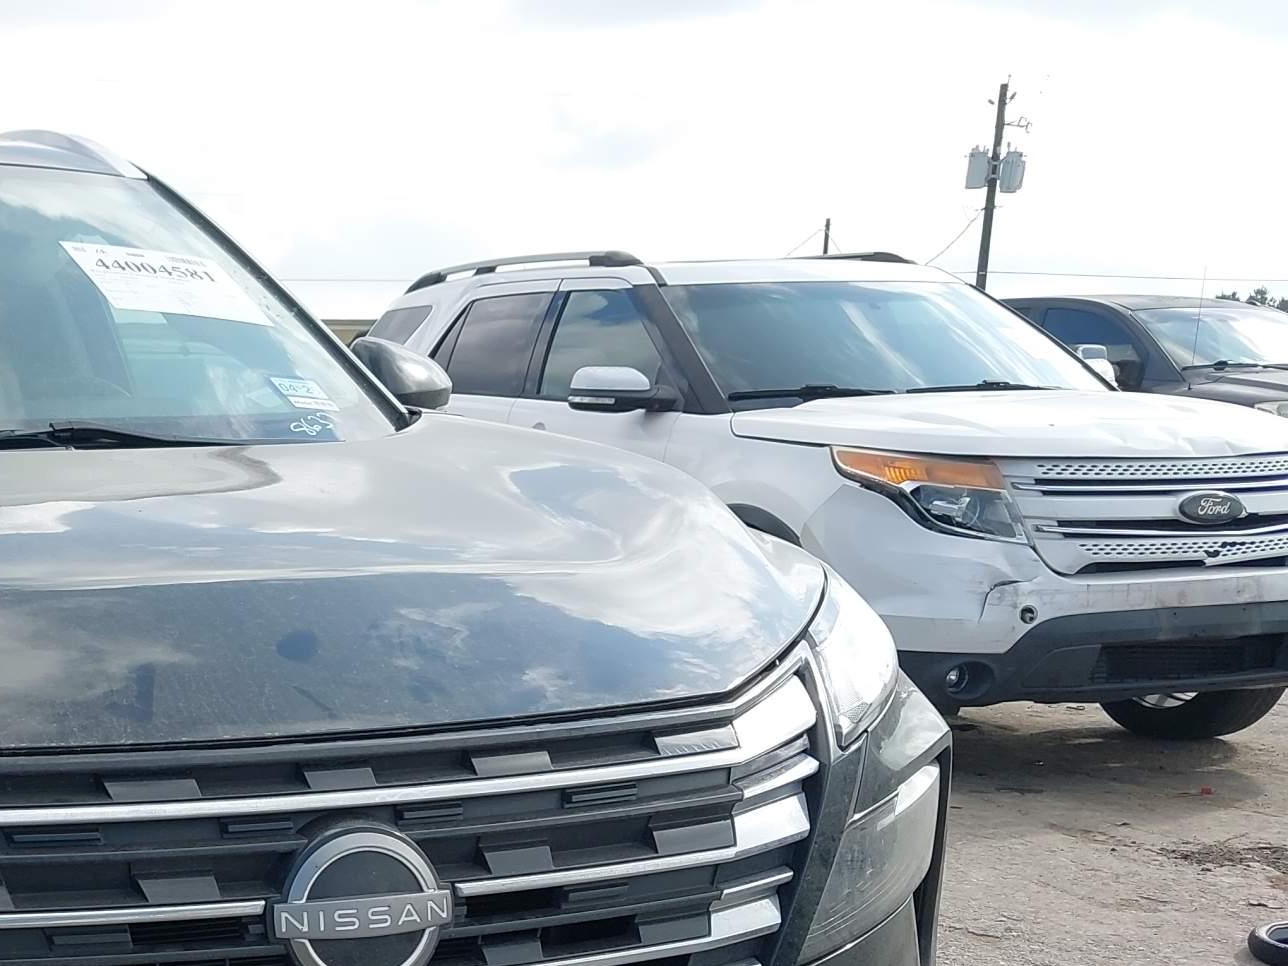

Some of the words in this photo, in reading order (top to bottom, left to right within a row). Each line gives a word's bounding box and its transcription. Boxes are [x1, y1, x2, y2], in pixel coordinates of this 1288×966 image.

[95, 258, 216, 283] 44004581
[1197, 497, 1231, 515] Ford
[280, 896, 449, 933] NISSAN
